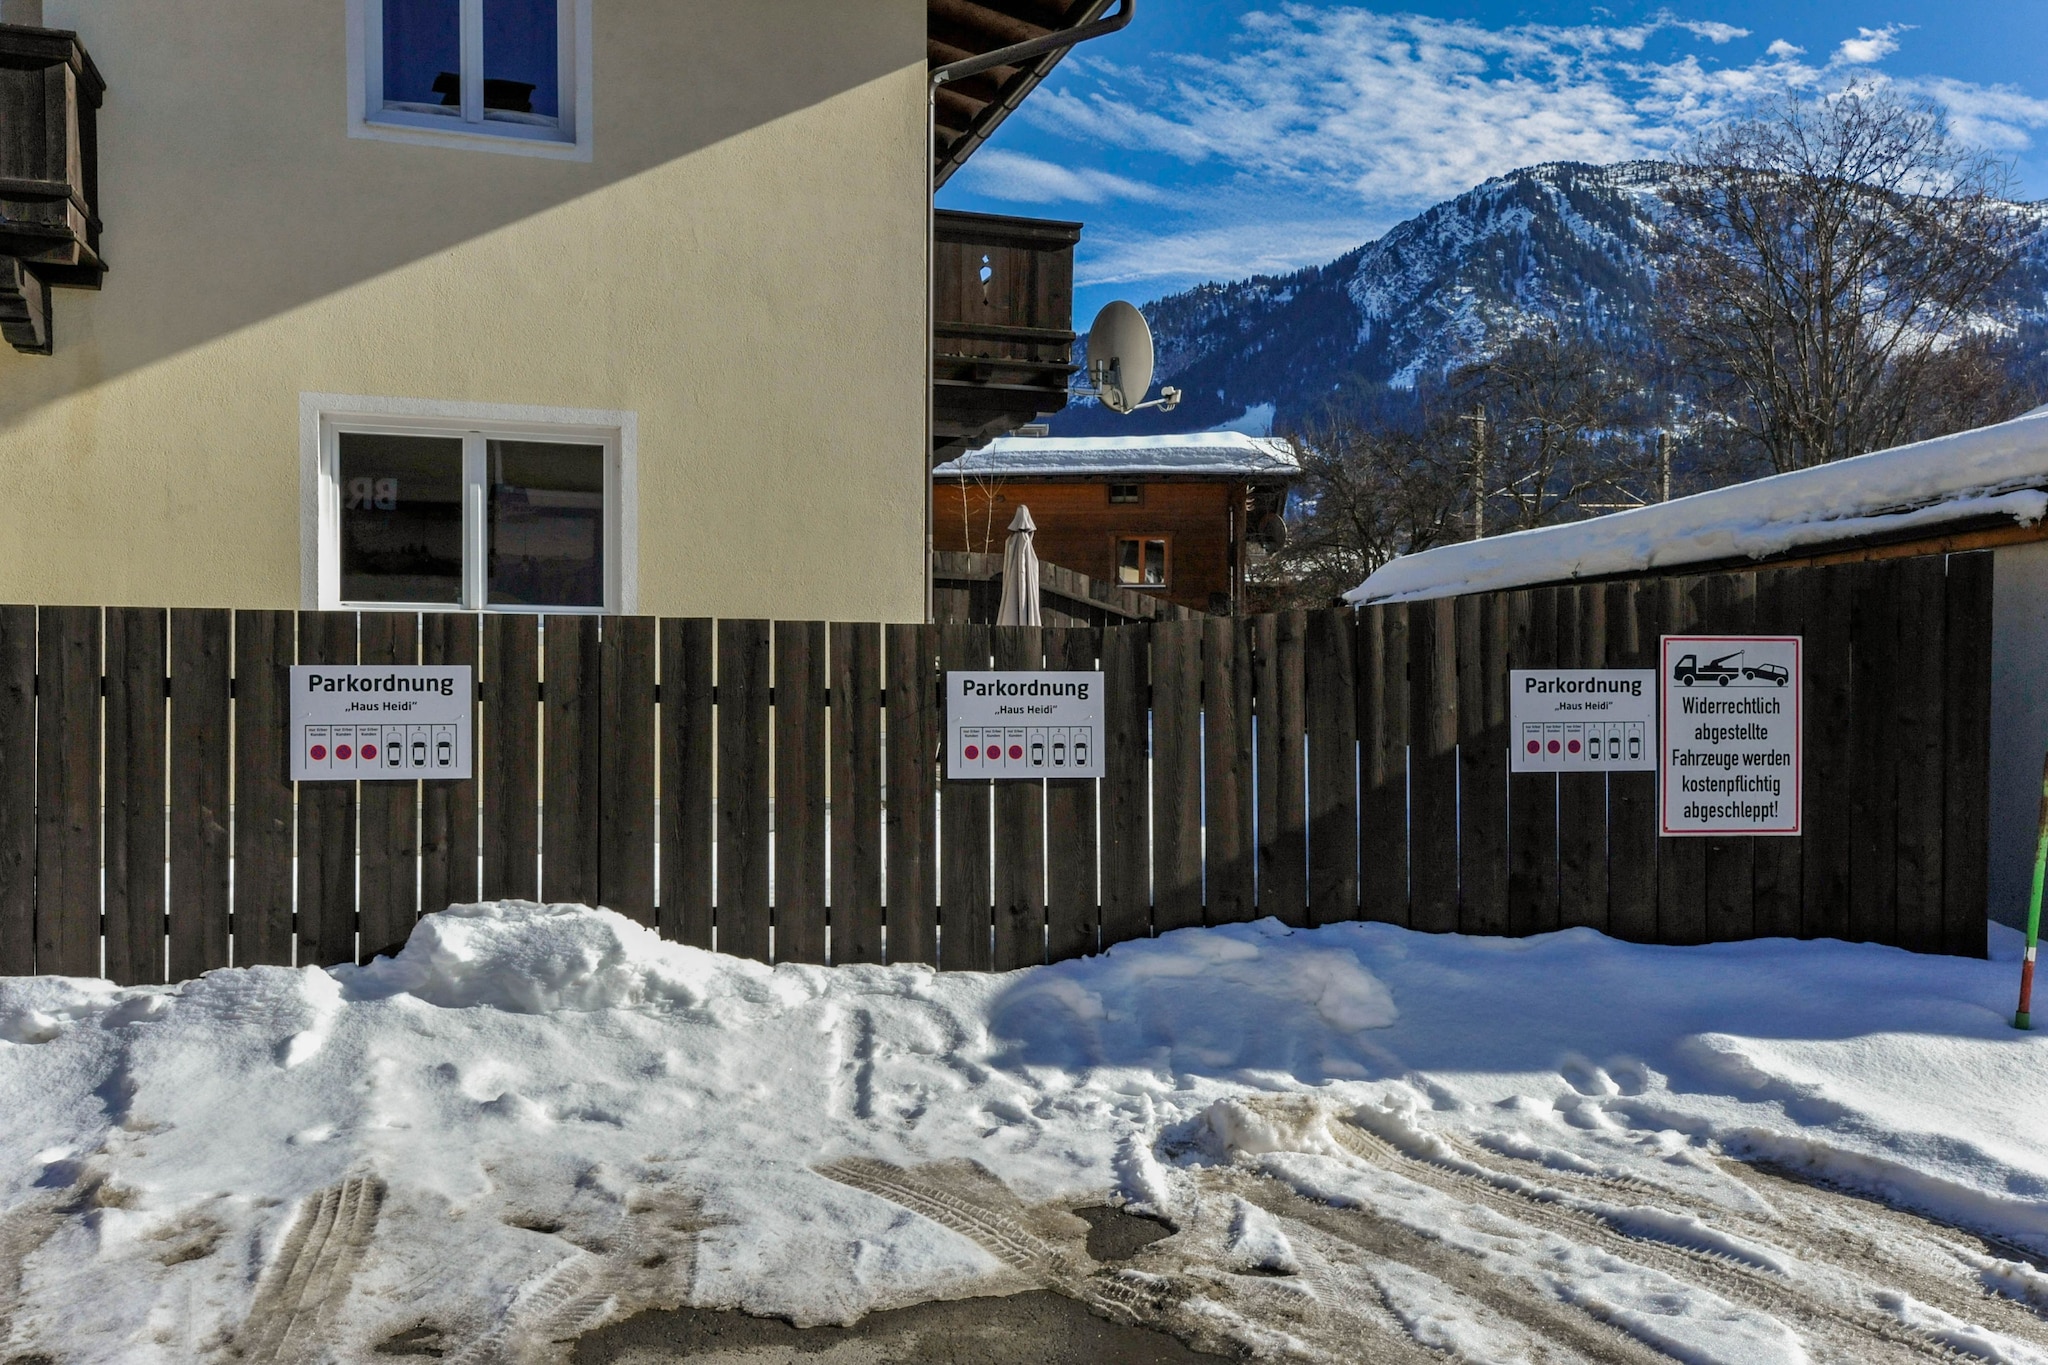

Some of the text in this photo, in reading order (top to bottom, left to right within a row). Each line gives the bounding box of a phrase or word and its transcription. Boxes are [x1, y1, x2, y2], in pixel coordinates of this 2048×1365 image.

[309, 674, 454, 696] Parkordnung
[963, 679, 1089, 700] Parkordnung
[1525, 677, 1642, 697] Parkordnung
[345, 702, 379, 712] „Haus
[994, 705, 1024, 715] „Haus
[1554, 702, 1582, 711] „Haus
[1682, 696, 1780, 714] Widerrechtlich
[1695, 723, 1768, 744] abgestellte
[1672, 749, 1790, 771] Fahrzeuge werden
[1682, 775, 1781, 797] kostenpflichtig
[1683, 800, 1778, 823] abgeschleppt!
